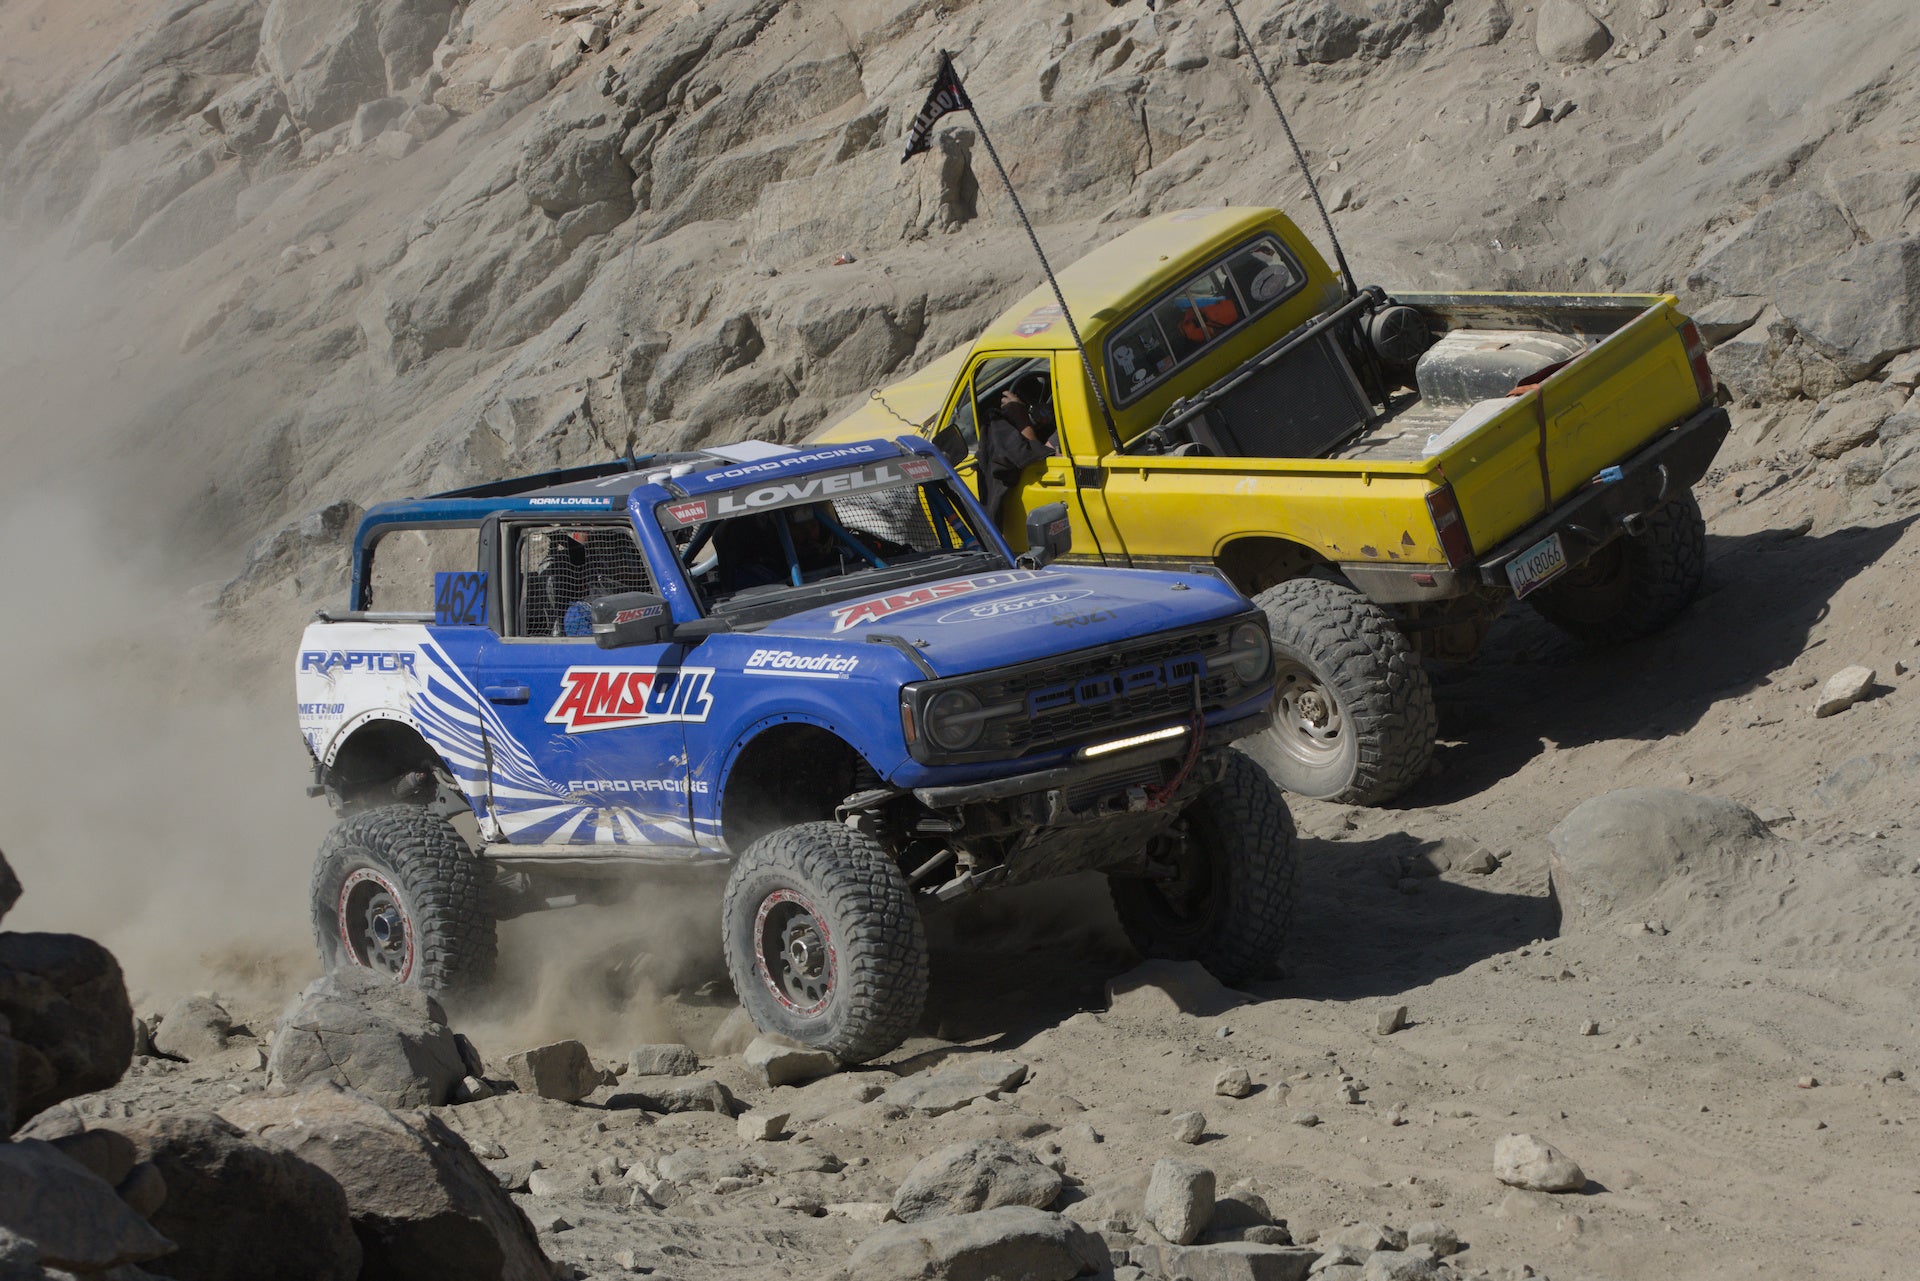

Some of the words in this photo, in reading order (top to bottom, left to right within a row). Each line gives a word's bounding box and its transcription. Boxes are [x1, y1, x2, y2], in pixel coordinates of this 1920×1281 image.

[706, 461, 780, 483] FORD
[782, 445, 875, 467] RACING
[907, 465, 930, 475] WARN
[717, 465, 902, 515] LOVELL
[675, 506, 705, 520] WARN
[1515, 543, 1561, 586] CLK8066
[435, 573, 489, 623] 4621
[835, 571, 1064, 631] AMSOIL
[969, 592, 1067, 617] Ford
[614, 605, 663, 623] AMSOIL
[301, 651, 419, 682] RAPTOR
[745, 649, 860, 672] BFGoodrich
[552, 670, 711, 728] AMSOIL
[1028, 653, 1207, 719] FORD
[298, 703, 345, 714] METHOD
[567, 780, 630, 793] FORD
[632, 779, 709, 794] RACING
